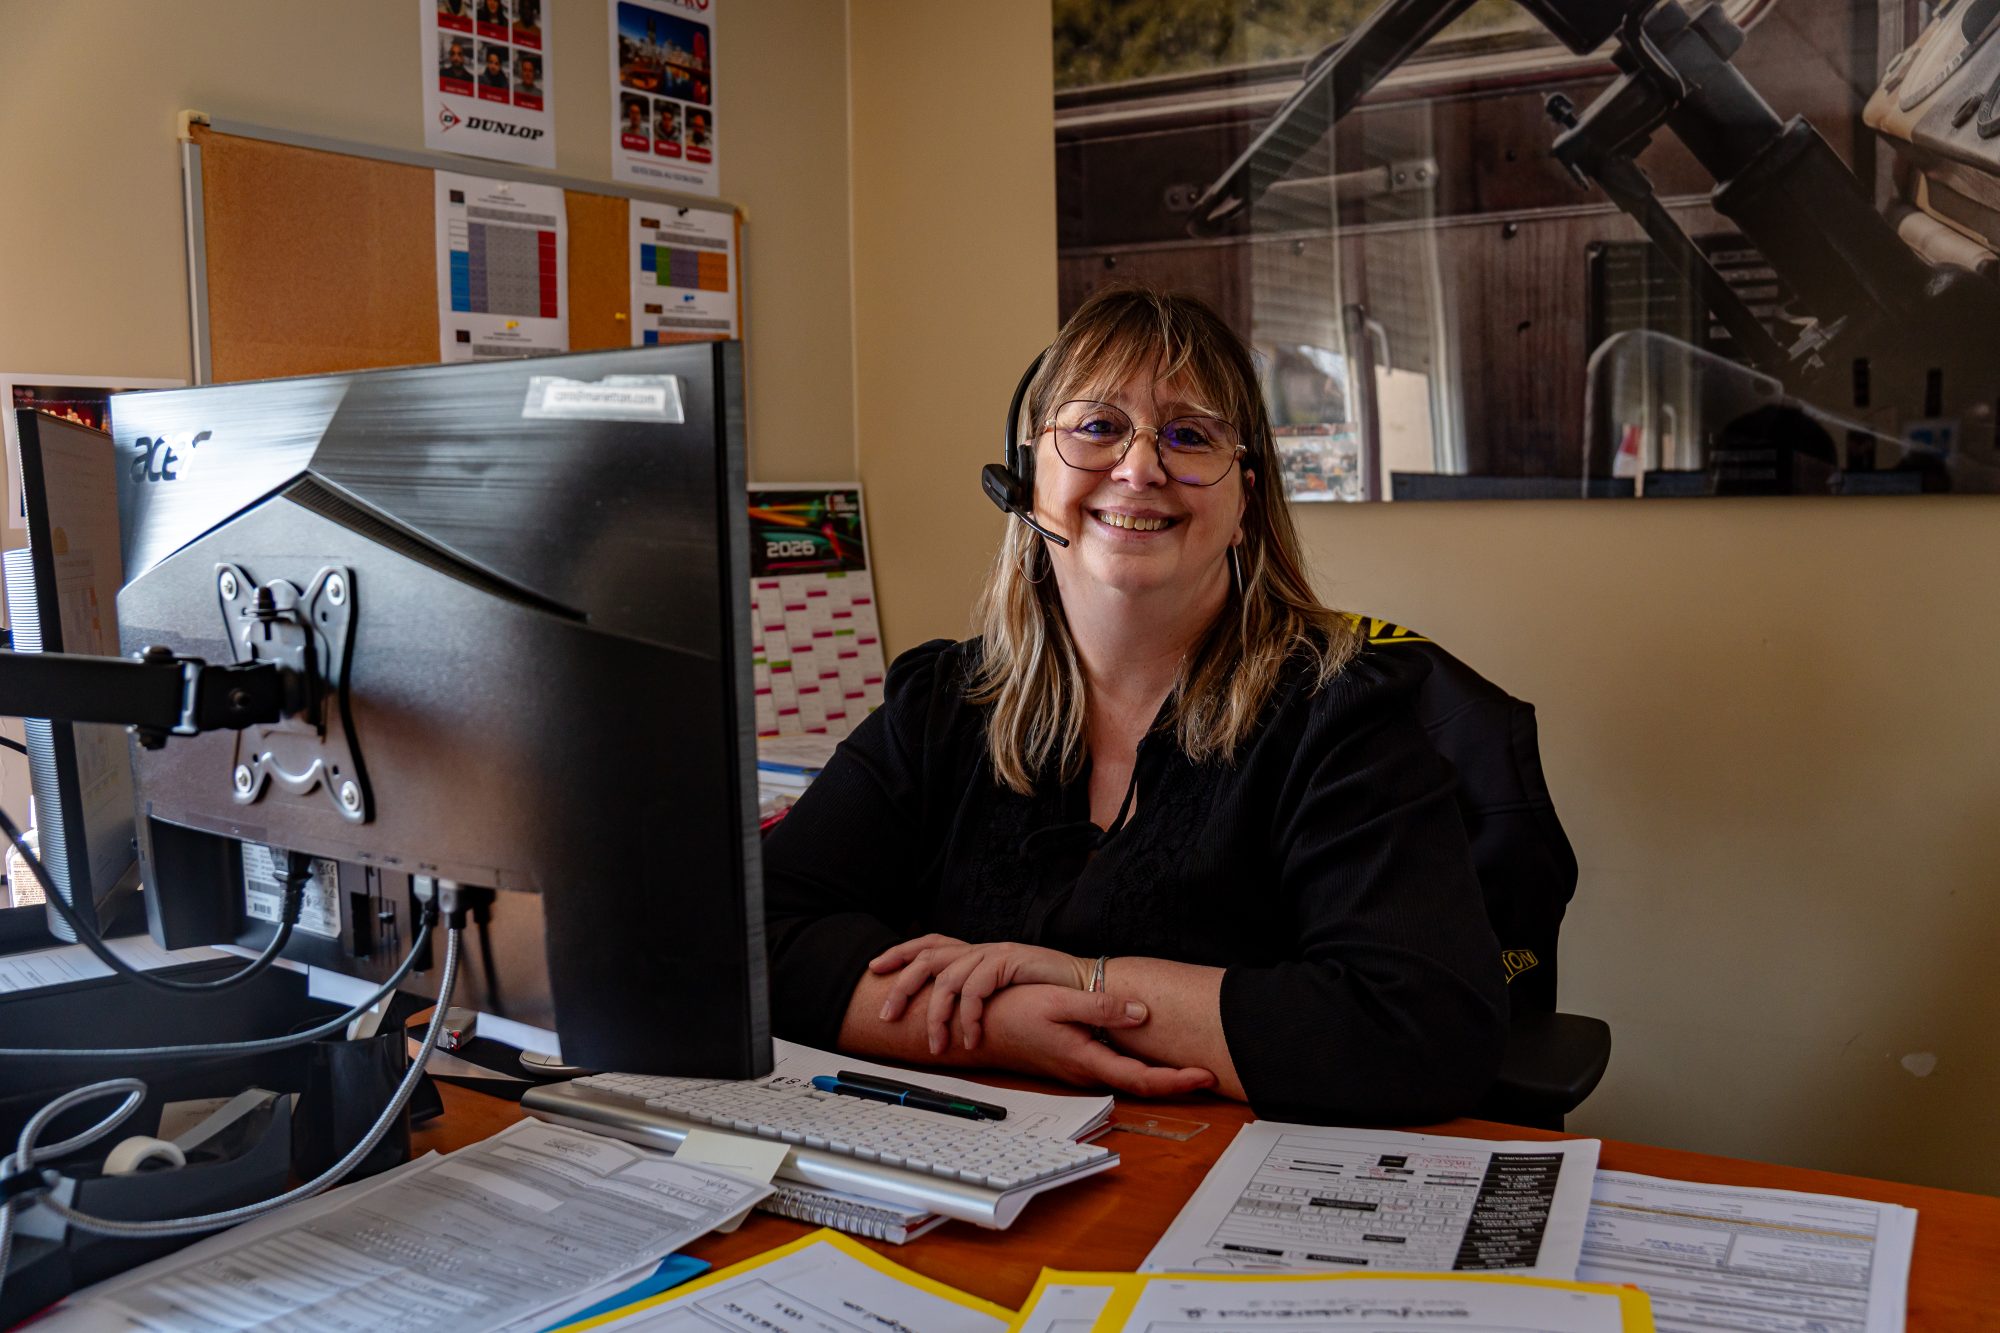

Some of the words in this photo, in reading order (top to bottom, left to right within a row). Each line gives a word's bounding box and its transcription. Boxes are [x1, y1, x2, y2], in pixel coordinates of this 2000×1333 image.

[465, 116, 544, 141] DUNLOP
[130, 430, 213, 483] acer
[766, 540, 816, 558] 2026
[1502, 951, 1535, 977] ION
